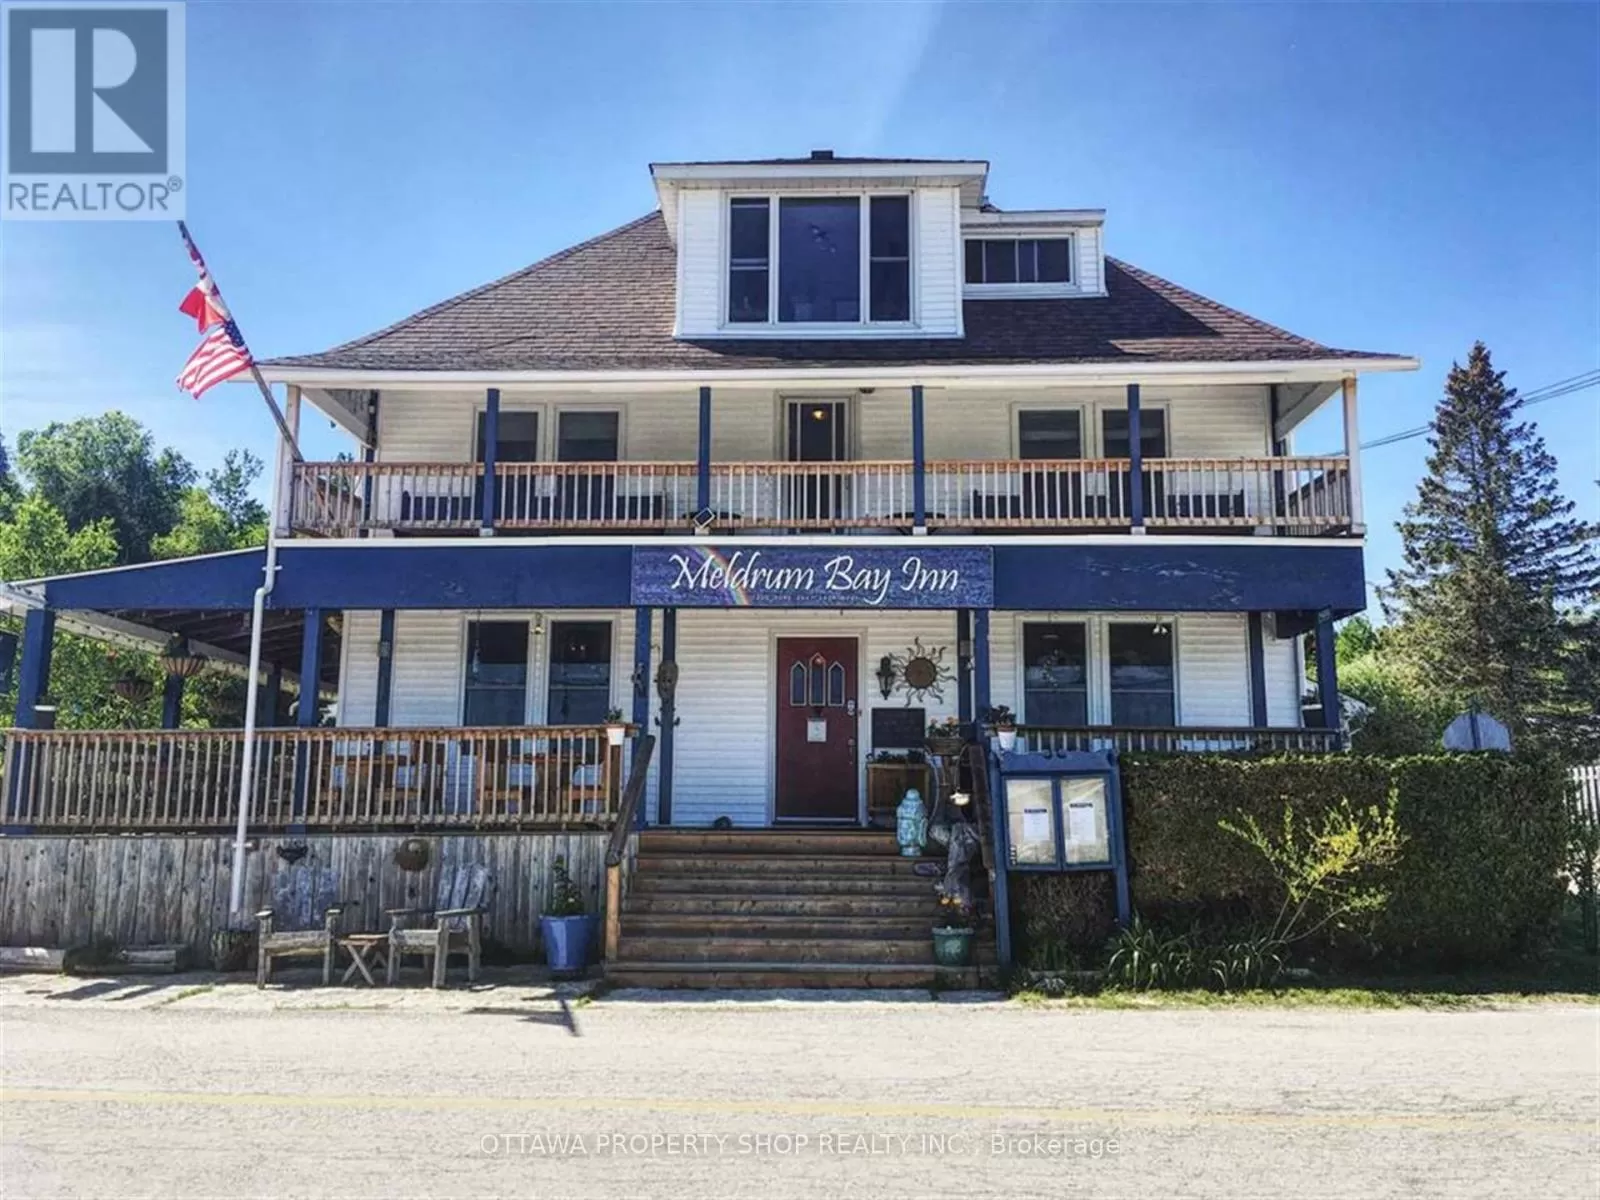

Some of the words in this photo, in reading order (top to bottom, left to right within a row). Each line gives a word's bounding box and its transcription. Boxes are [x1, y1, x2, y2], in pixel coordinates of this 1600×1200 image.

[668, 551, 815, 590] Meldrum
[824, 555, 891, 605] Bay
[900, 556, 959, 592] Inn
